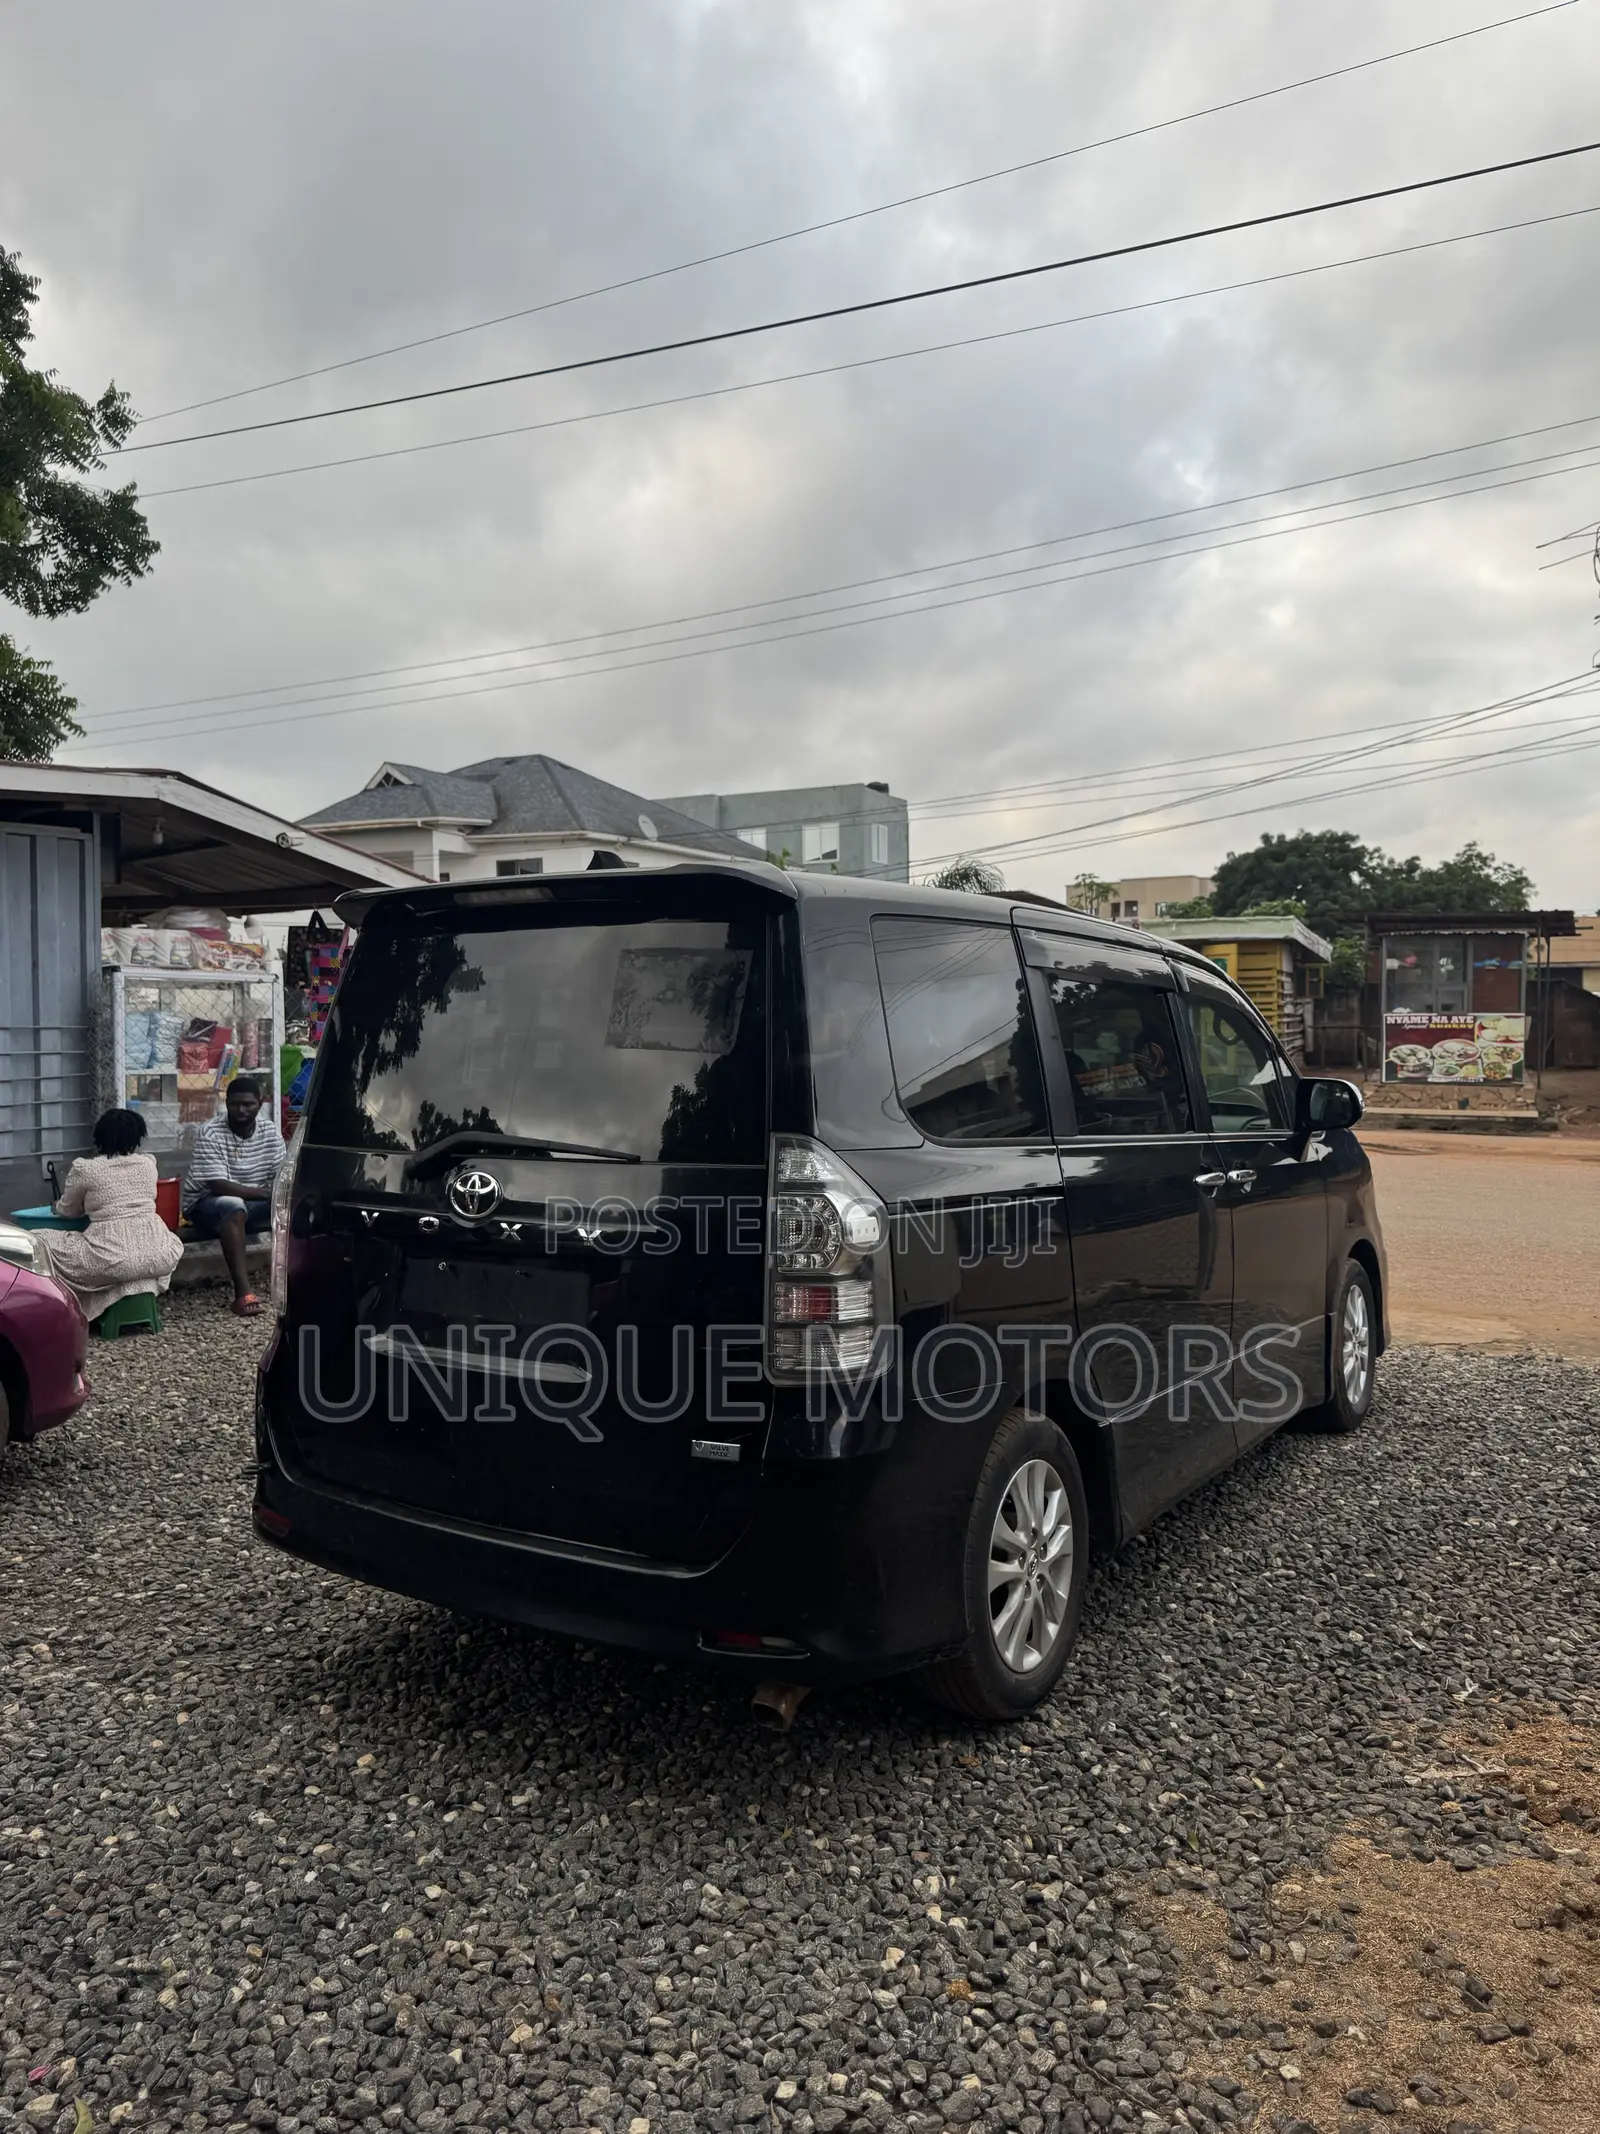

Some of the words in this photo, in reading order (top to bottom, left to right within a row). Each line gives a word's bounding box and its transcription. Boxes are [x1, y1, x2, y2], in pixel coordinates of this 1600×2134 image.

[1386, 1015, 1429, 1024] NYAME
[1431, 1015, 1448, 1024] NA
[1450, 1015, 1474, 1024] AYE
[361, 1210, 602, 1246] VOXY
